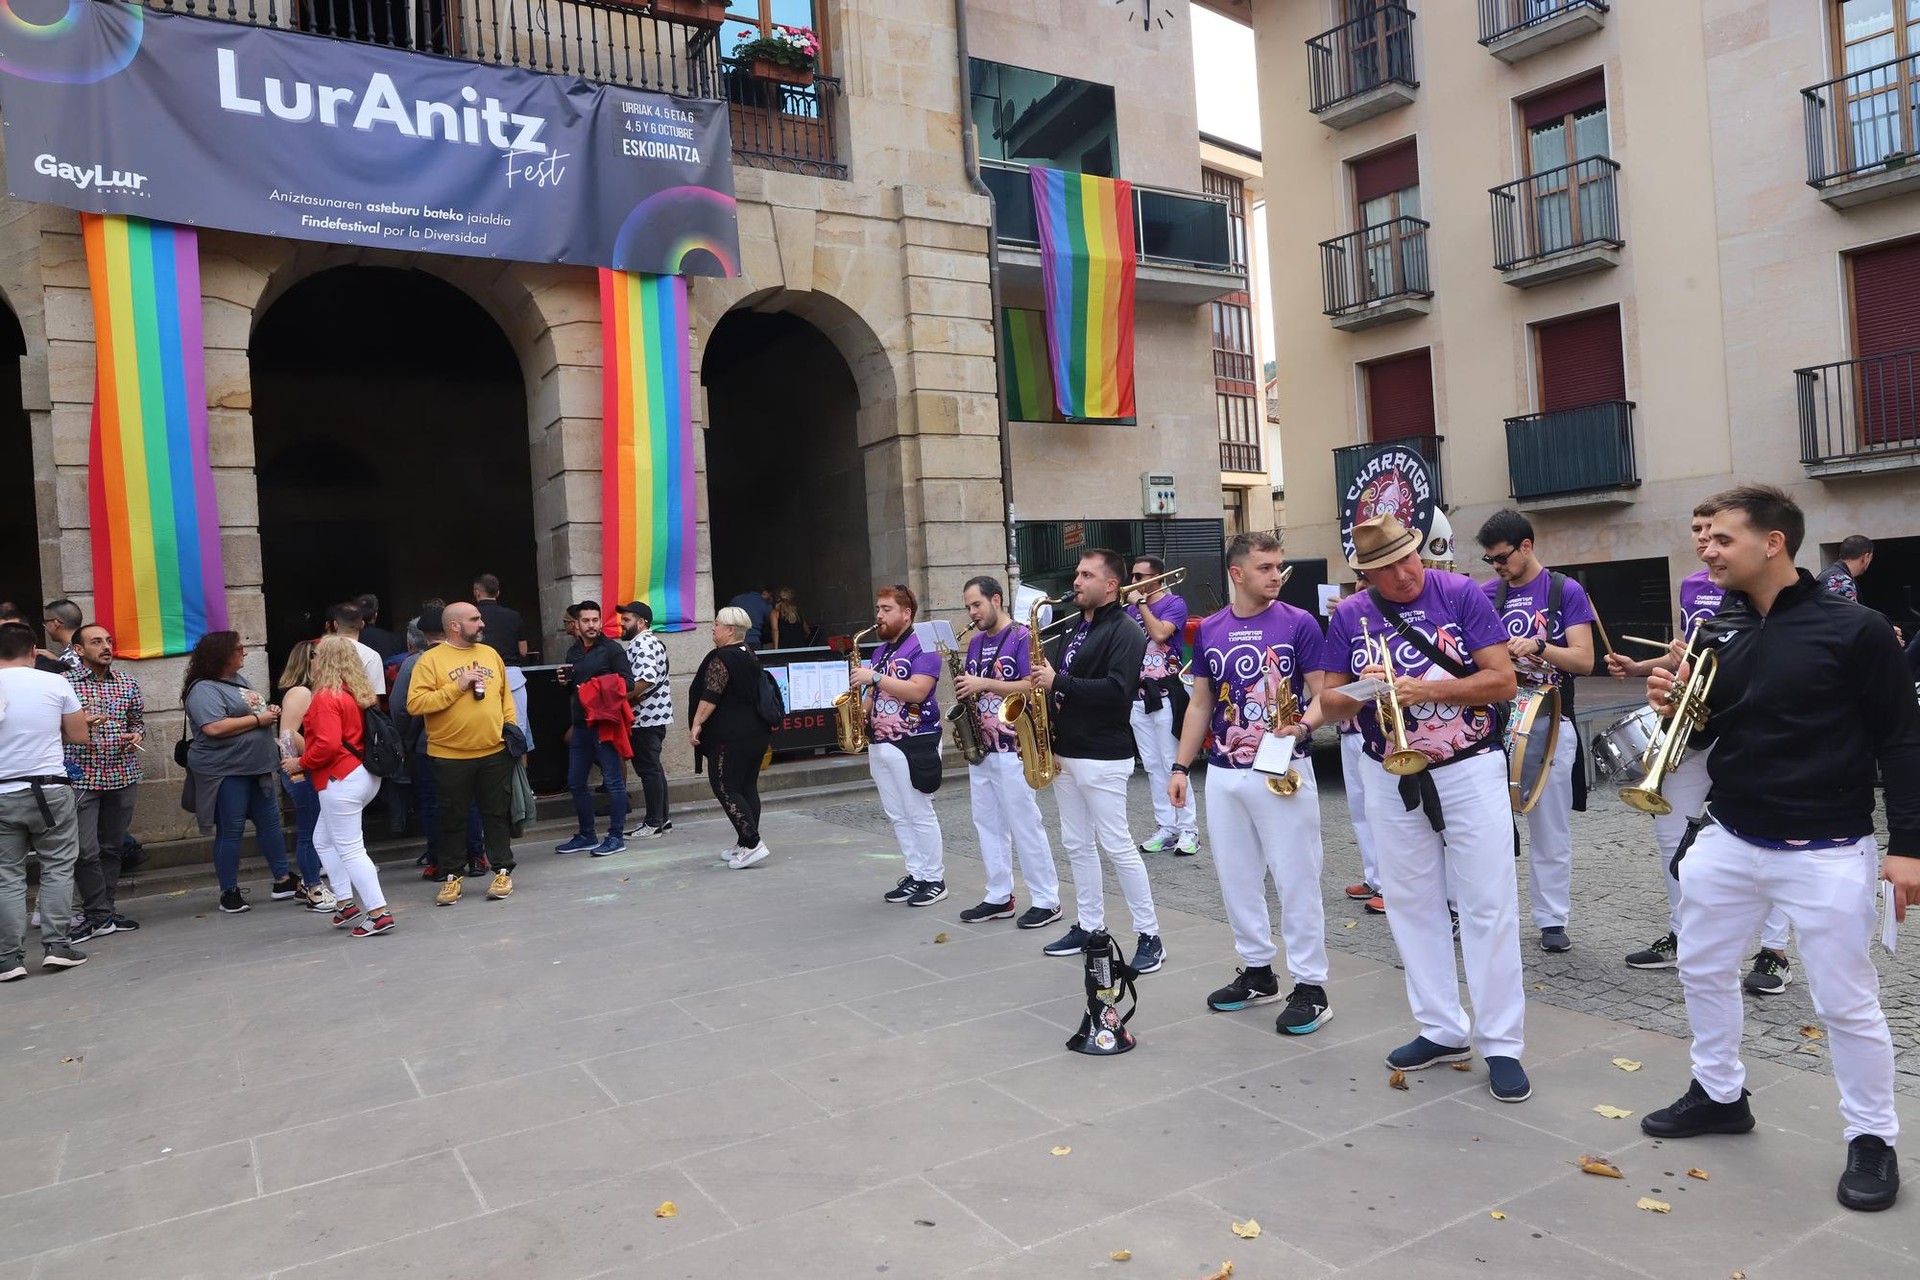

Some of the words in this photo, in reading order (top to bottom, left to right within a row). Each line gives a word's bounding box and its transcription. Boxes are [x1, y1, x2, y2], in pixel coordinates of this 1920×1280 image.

[217, 48, 548, 153] LurAnitz
[622, 102, 653, 117] URRIAK
[664, 108, 670, 119] 5
[671, 109, 687, 122] ETA
[688, 112, 694, 124] 6
[635, 120, 641, 132] 5
[643, 122, 649, 133] Y
[650, 123, 657, 134] 6
[658, 124, 694, 140] OCTUBRE
[622, 138, 700, 163] ESKORIATZA
[34, 153, 148, 189] GayLur
[501, 149, 571, 189] Fest
[269, 189, 362, 210] Aniztasunaren
[366, 202, 420, 216] asteburu
[423, 205, 464, 221] bateko
[467, 212, 511, 226] jaialdia
[302, 214, 381, 234] Findefestival
[383, 227, 405, 238] por
[409, 225, 420, 238] la
[424, 228, 487, 244] Diversidad
[1347, 452, 1430, 503] CHARANGA
